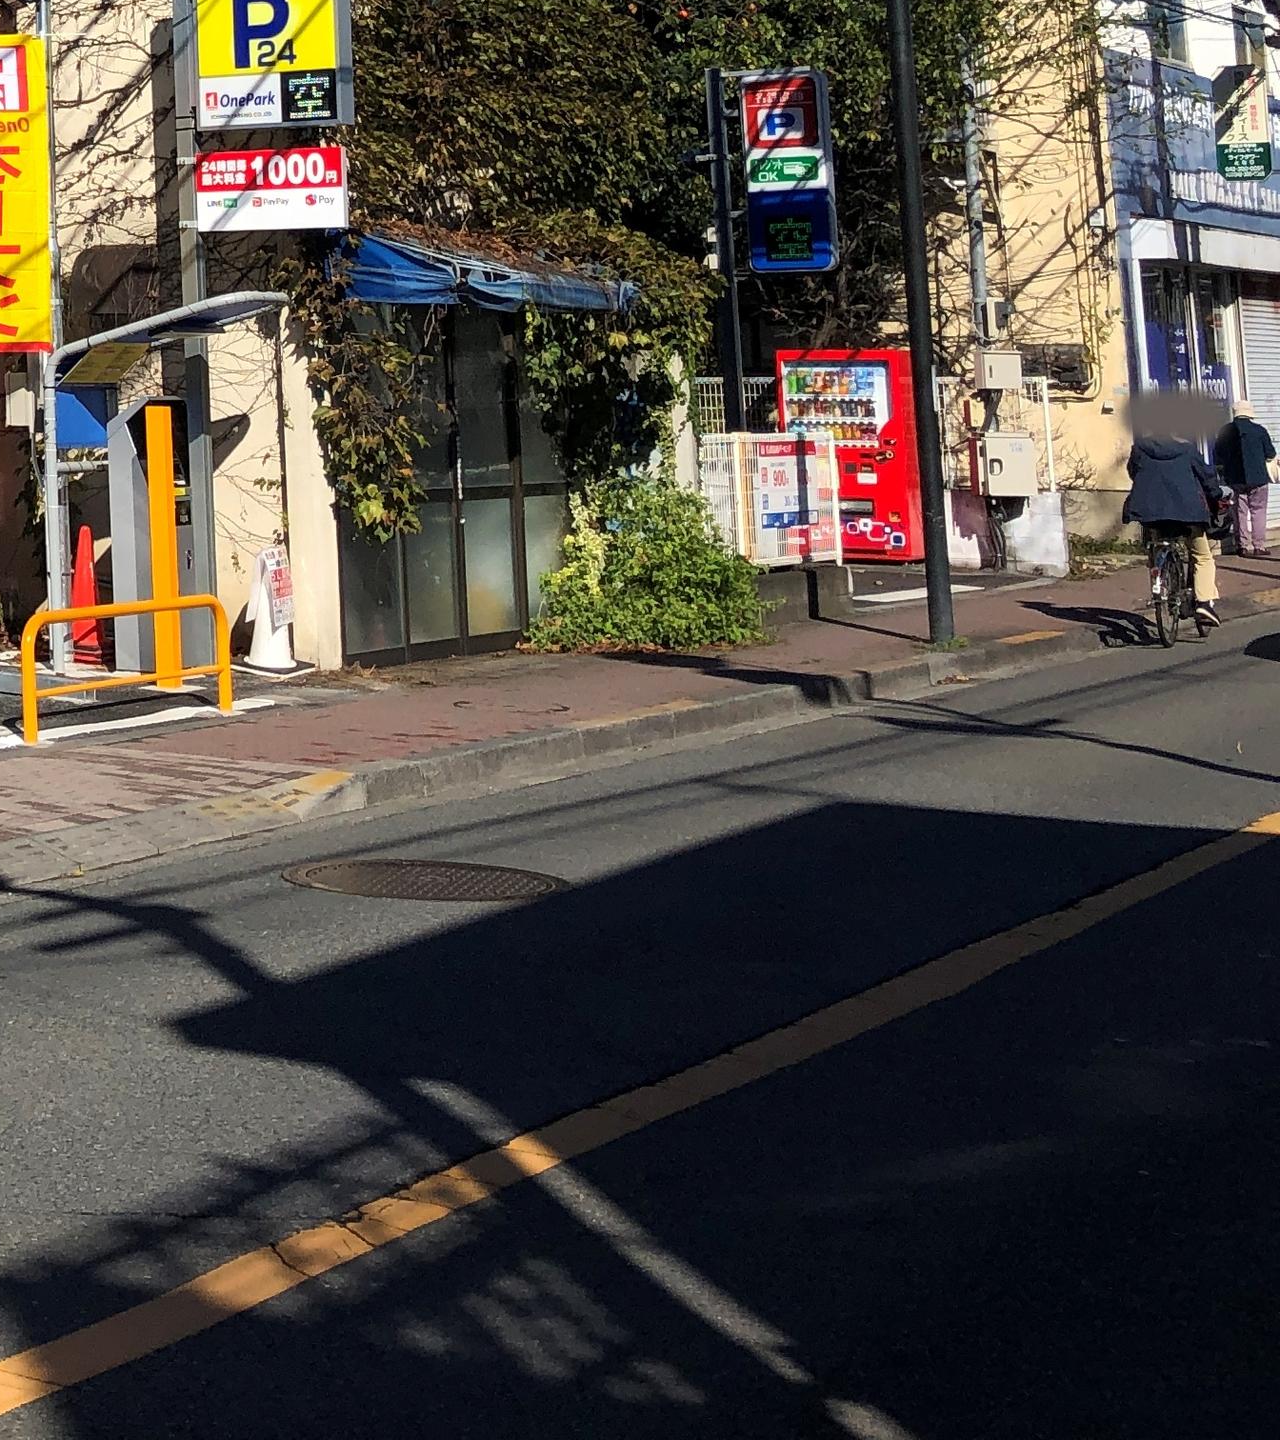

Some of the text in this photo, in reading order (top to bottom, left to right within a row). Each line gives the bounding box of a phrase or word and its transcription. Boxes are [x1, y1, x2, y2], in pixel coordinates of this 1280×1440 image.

[257, 40, 297, 66] 24
[220, 91, 276, 108] OnePark
[766, 113, 795, 136] P
[758, 172, 779, 182] OK
